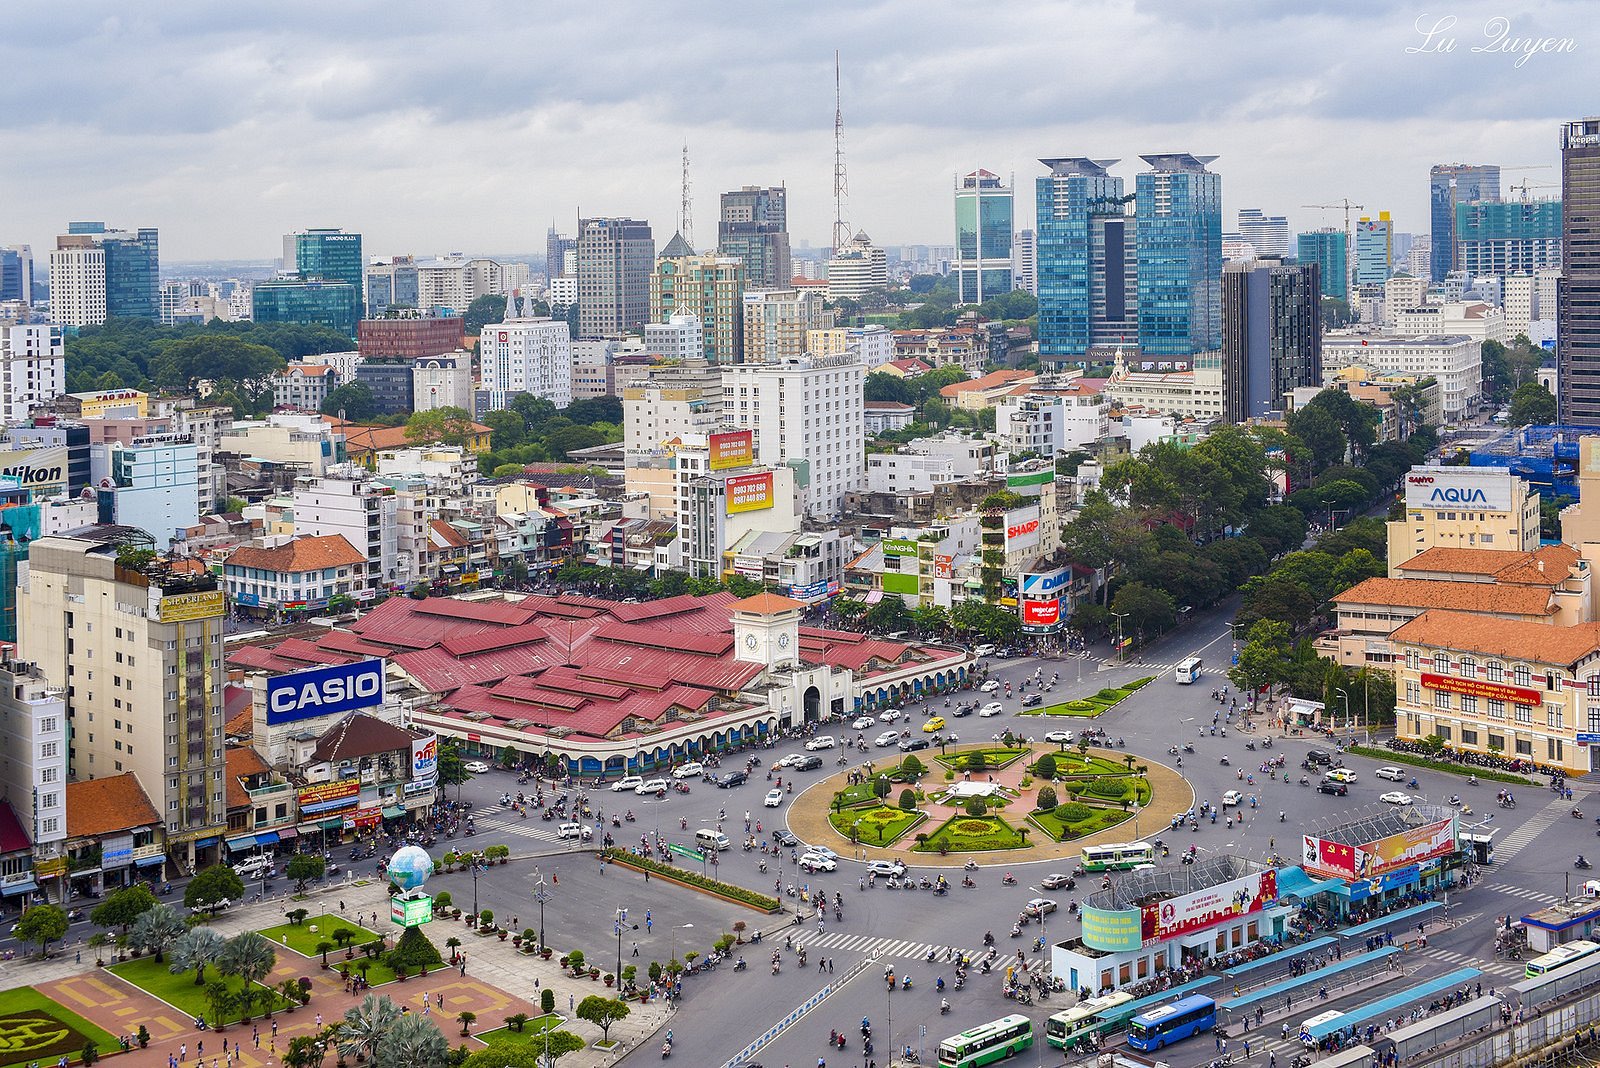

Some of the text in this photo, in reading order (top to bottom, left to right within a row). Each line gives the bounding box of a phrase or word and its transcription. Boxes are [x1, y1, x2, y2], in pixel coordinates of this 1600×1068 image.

[3, 465, 62, 483] Nikon
[1408, 476, 1434, 484] SANYO
[1431, 487, 1487, 502] AQUA
[1008, 520, 1039, 538] SHARP
[168, 593, 218, 605] SILVERLAND
[271, 671, 380, 713] CASIO
